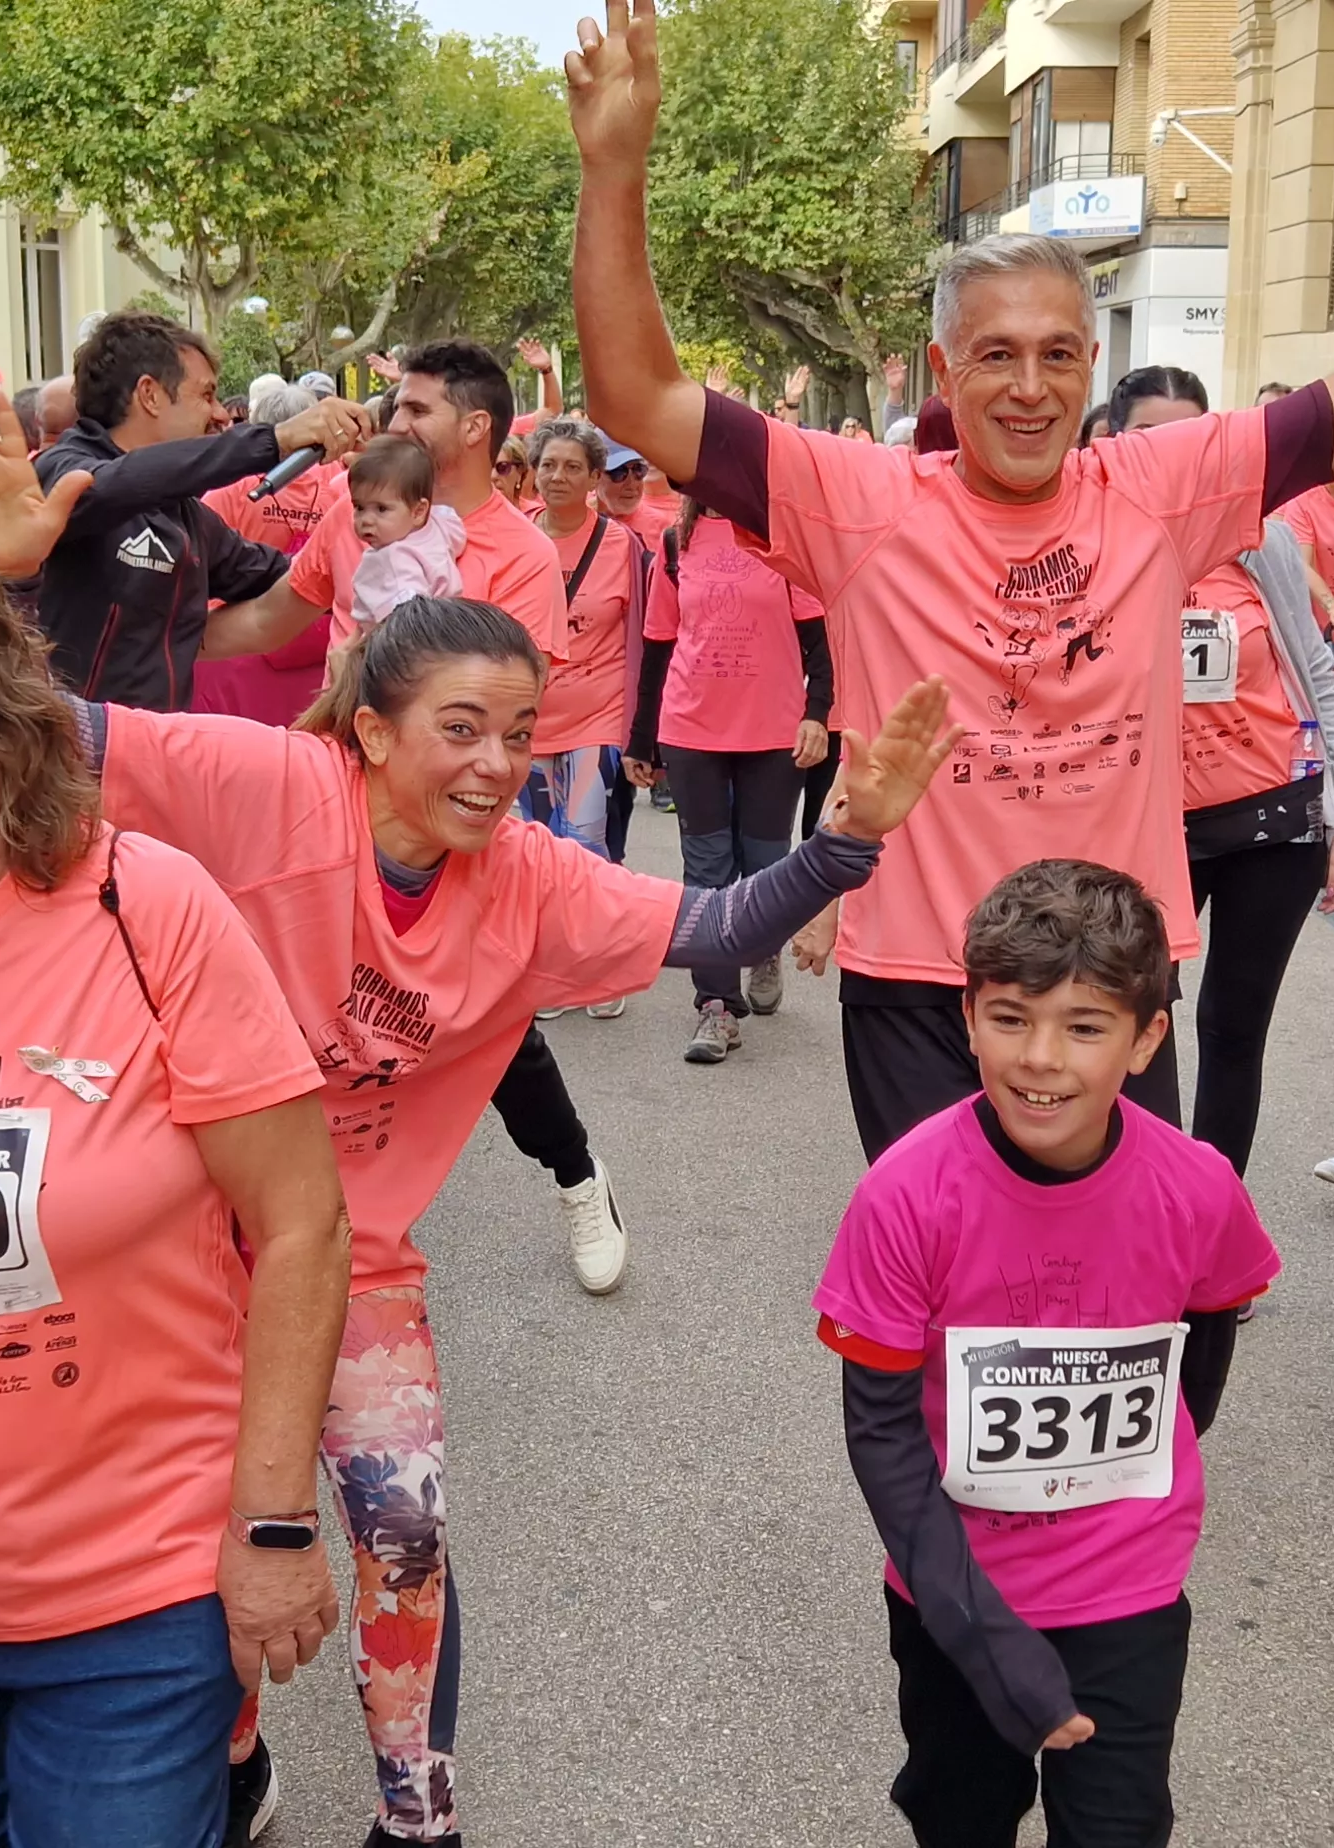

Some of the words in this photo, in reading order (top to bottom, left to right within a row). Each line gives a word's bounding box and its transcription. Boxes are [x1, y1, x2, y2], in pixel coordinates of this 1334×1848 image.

[351, 963, 430, 1019] CORRAMOS
[372, 1002, 436, 1046] CIENCIA
[967, 1352, 977, 1364] XI
[981, 1367, 1066, 1384] CONTRA
[1071, 1365, 1092, 1383] EL
[1096, 1357, 1160, 1379] CÁNCER
[1052, 1350, 1108, 1365] HUESCA
[976, 1386, 1155, 1463] 3313
